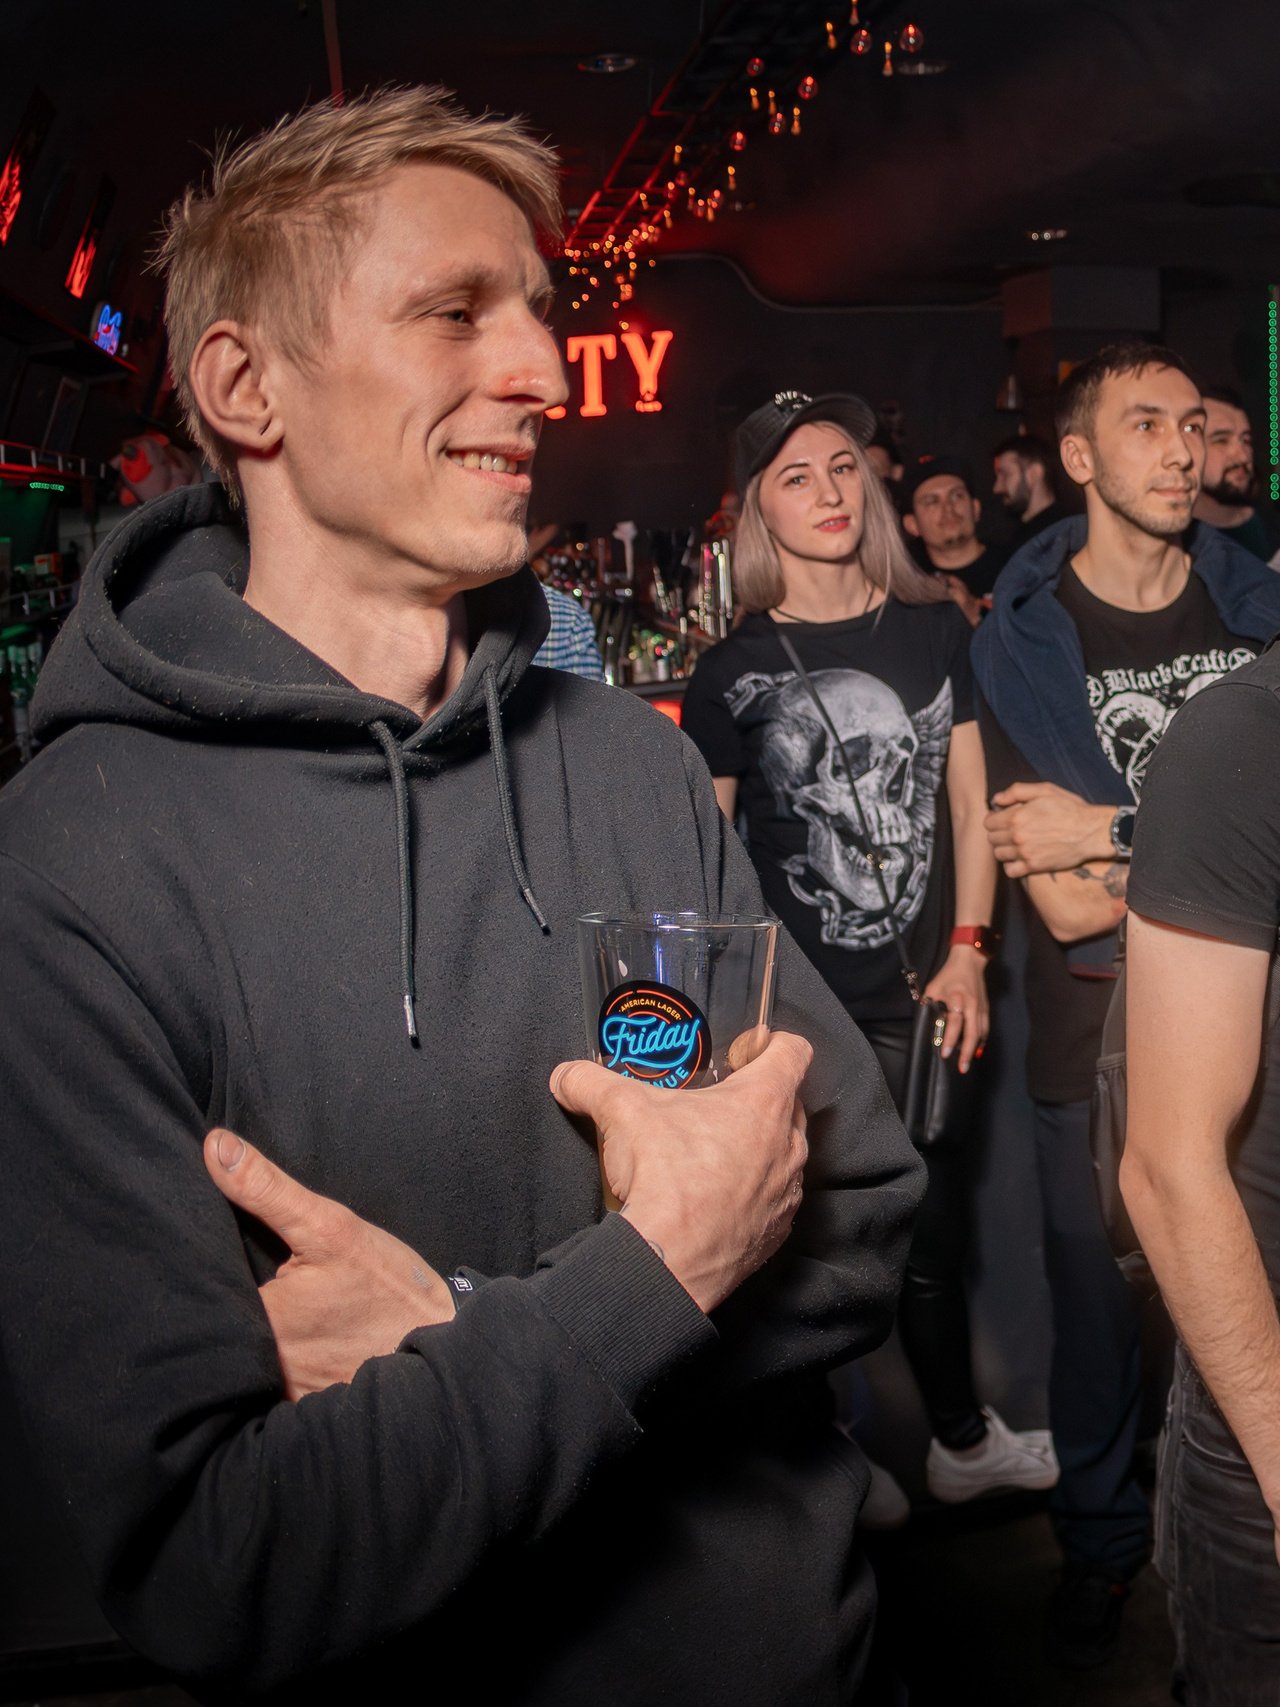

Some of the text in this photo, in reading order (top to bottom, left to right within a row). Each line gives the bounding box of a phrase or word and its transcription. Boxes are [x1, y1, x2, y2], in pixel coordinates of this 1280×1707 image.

[544, 329, 674, 421] TY
[620, 998, 682, 1021] AMERICAN LAGER
[602, 1016, 700, 1069] Friday
